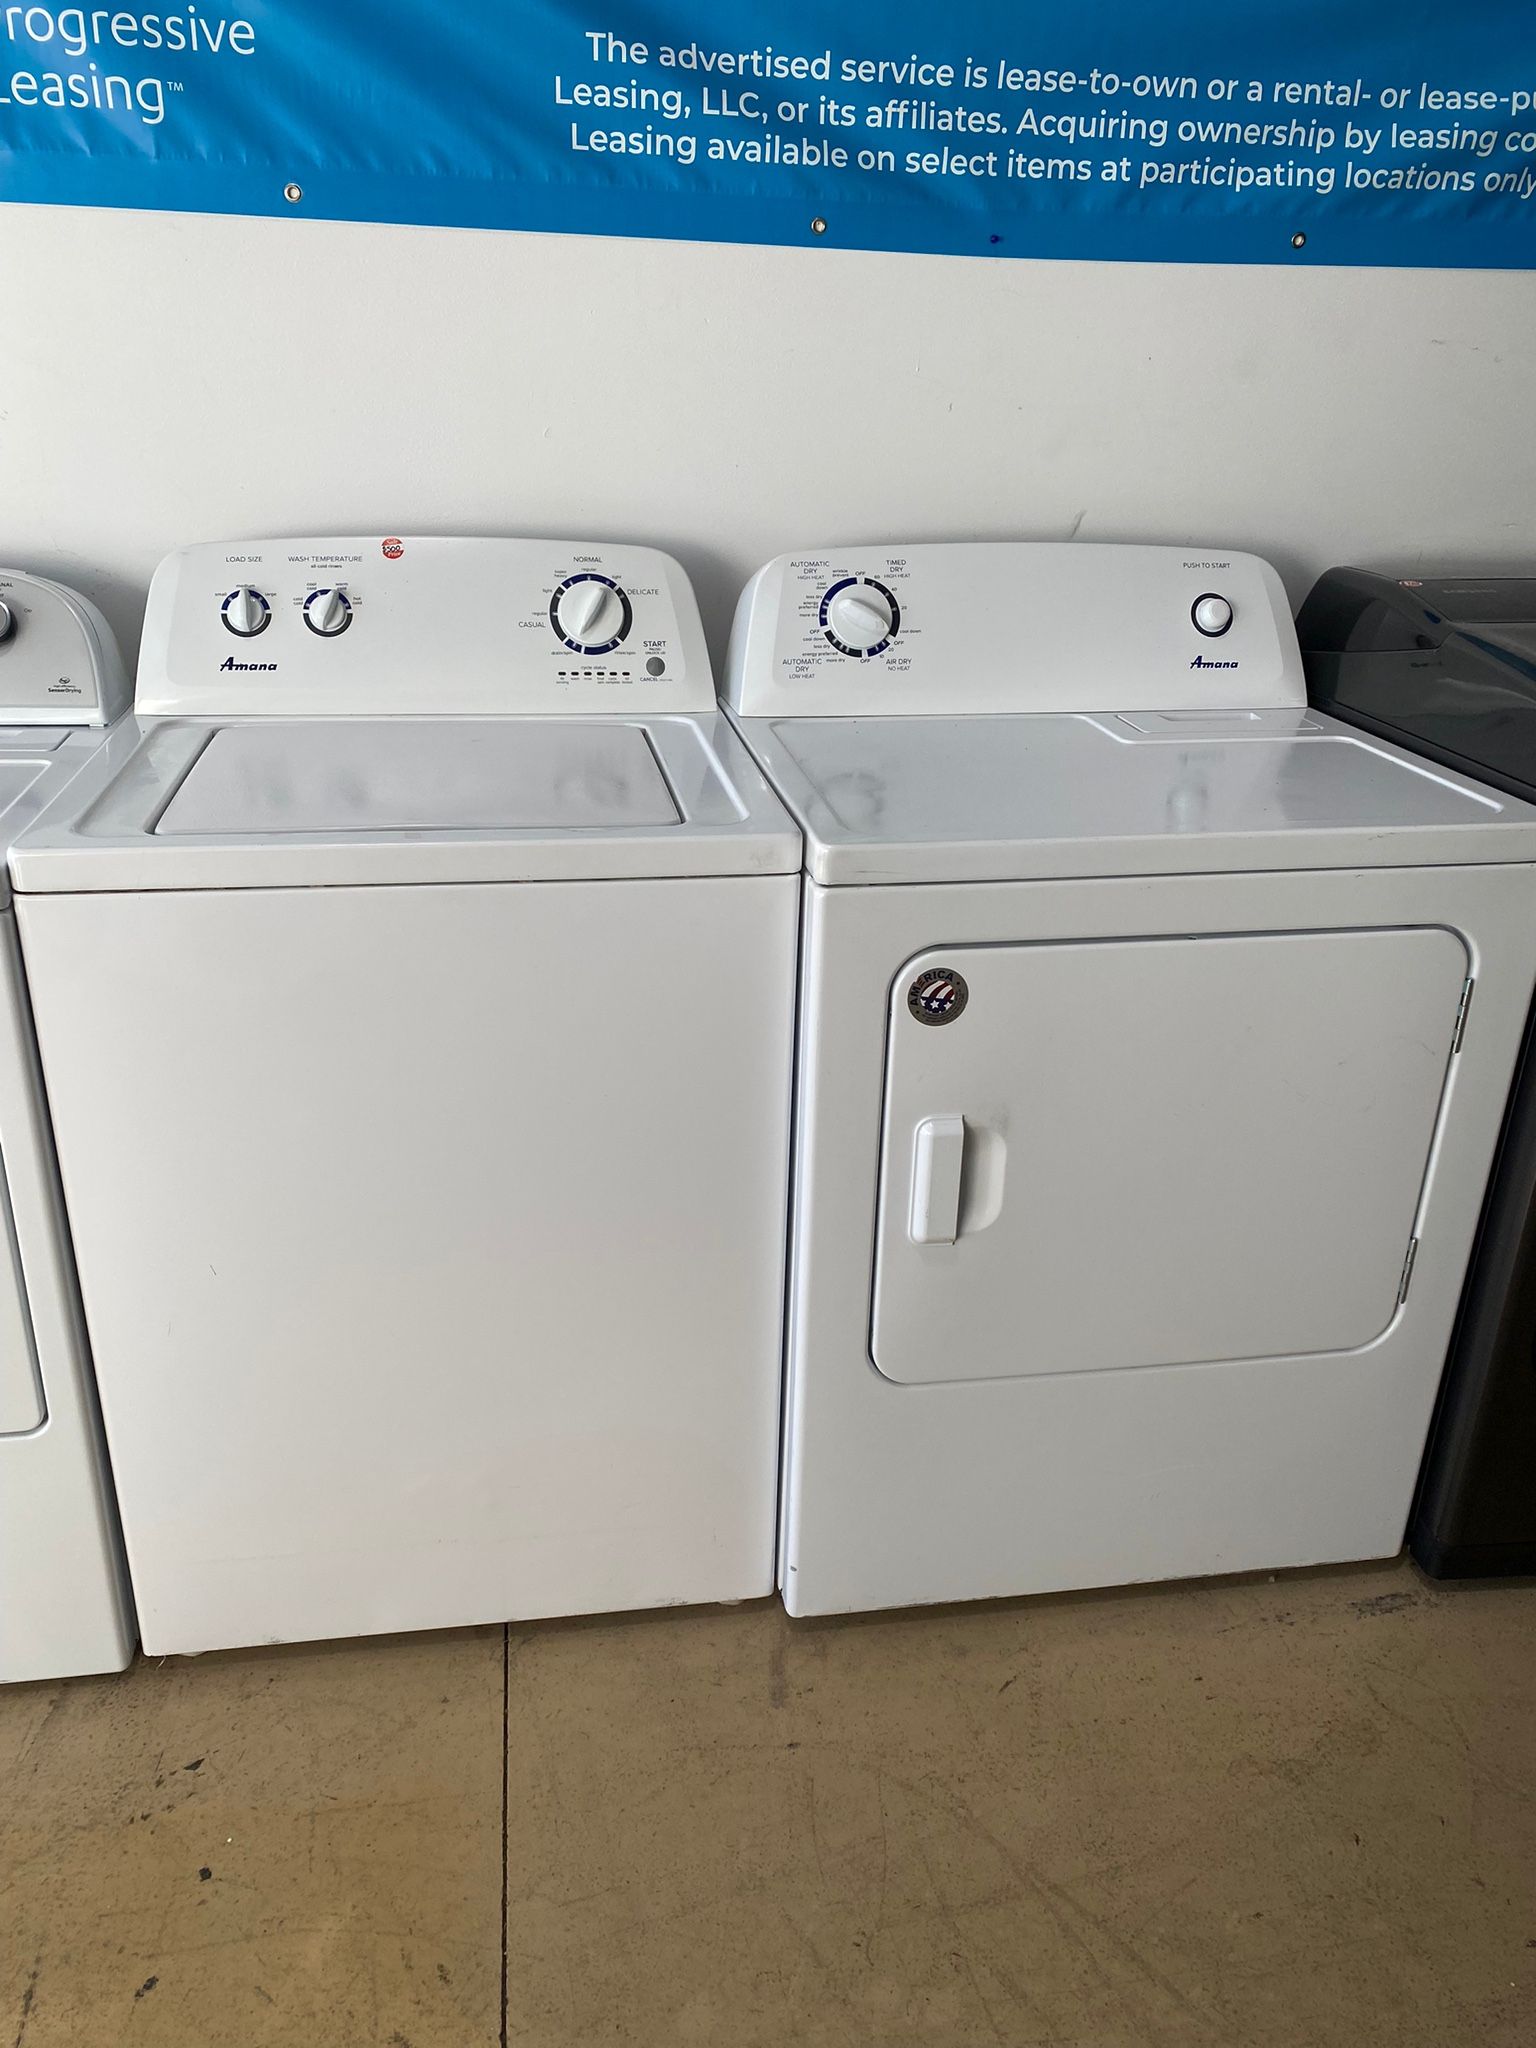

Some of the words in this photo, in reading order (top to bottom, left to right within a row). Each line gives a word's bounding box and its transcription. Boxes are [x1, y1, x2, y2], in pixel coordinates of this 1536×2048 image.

[0, 5, 255, 56] rogressive
[585, 31, 649, 64] The
[658, 43, 831, 81] advertised
[840, 54, 955, 87] service
[963, 57, 988, 89] is
[996, 60, 1198, 99] lease-to-own
[1207, 79, 1239, 100] or
[1246, 80, 1263, 102] a
[1273, 79, 1371, 107] rental-
[1379, 87, 1411, 109] or
[554, 76, 691, 120] Leasing,
[702, 87, 769, 125] LLC,
[776, 100, 809, 123] or
[819, 95, 856, 127] its
[865, 99, 1008, 135] affiliates.
[1015, 108, 1169, 147] Acquiring
[1177, 118, 1335, 154] ownership
[1344, 121, 1382, 155] by
[1390, 121, 1498, 157] leasing
[570, 122, 697, 165] Leasing
[707, 133, 849, 168] available
[857, 149, 895, 172] on
[904, 146, 998, 177] select
[1006, 148, 1092, 181] items
[1100, 157, 1132, 182] at
[1139, 156, 1336, 194] participating
[1344, 161, 1476, 193] locations
[220, 656, 278, 672] Amana
[1190, 655, 1239, 670] Amana
[910, 970, 954, 1006] AMERICA
